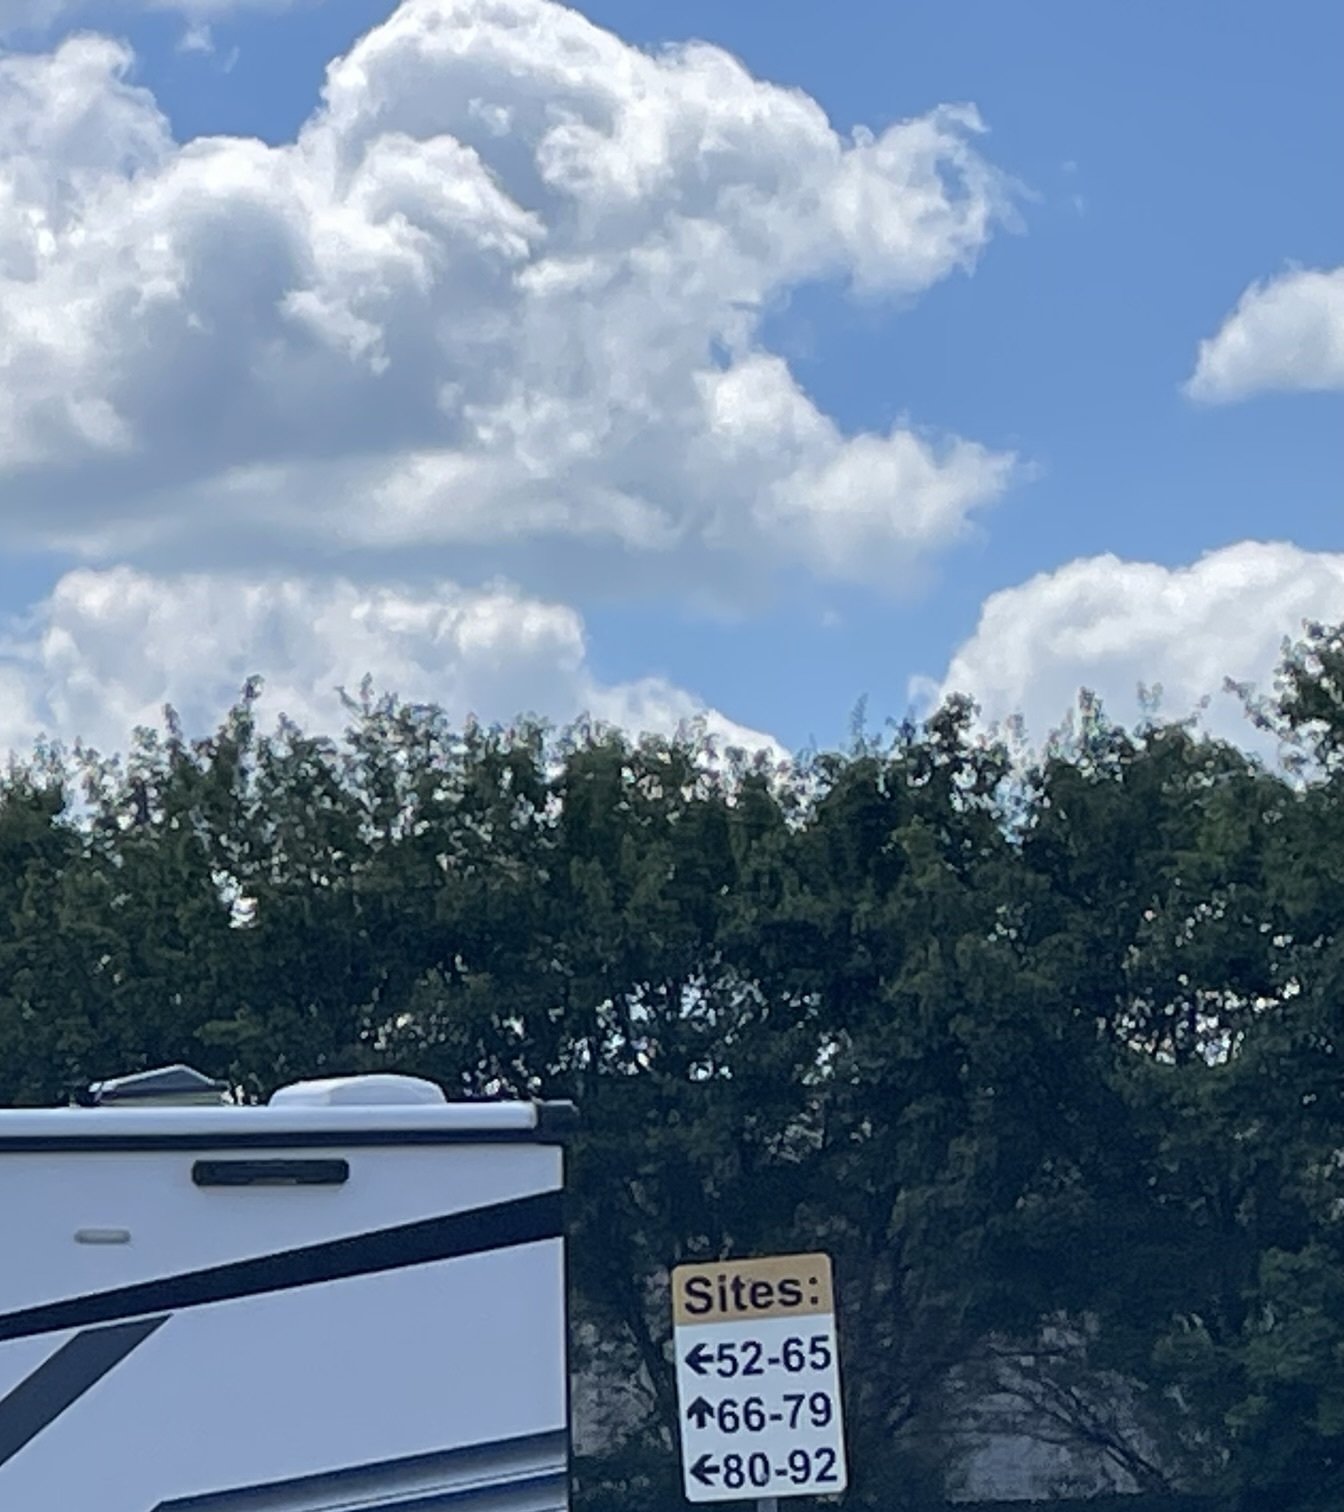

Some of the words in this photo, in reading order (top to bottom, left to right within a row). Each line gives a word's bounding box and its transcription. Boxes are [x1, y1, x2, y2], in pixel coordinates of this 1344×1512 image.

[684, 1274, 818, 1314] Sites:
[716, 1335, 831, 1377] 52-65
[717, 1392, 832, 1433] 66-79
[723, 1447, 837, 1488] 80-92
